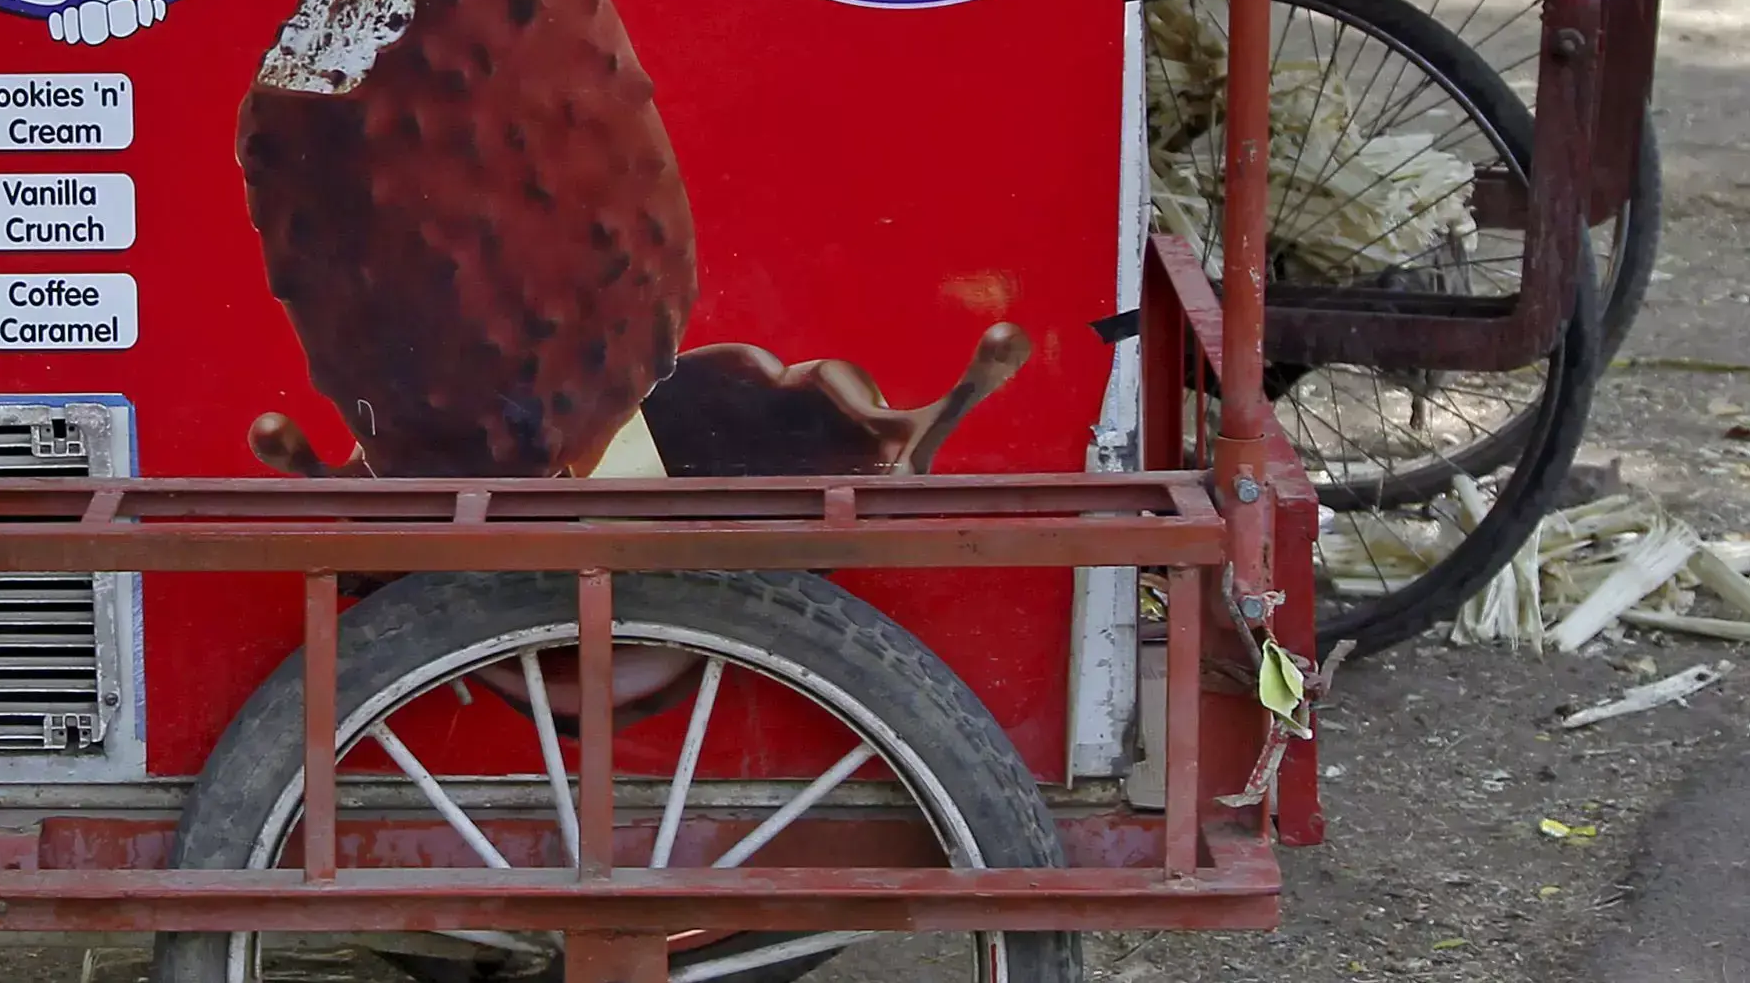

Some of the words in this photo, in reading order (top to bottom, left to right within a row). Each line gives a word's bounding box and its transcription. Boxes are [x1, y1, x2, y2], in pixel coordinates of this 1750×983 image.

[93, 83, 126, 107] 'n'
[8, 118, 102, 145] Cream
[2, 180, 97, 207] Vanilla
[5, 216, 105, 244] Crunch
[8, 280, 100, 308] Coffee
[0, 316, 119, 344] Caramel
